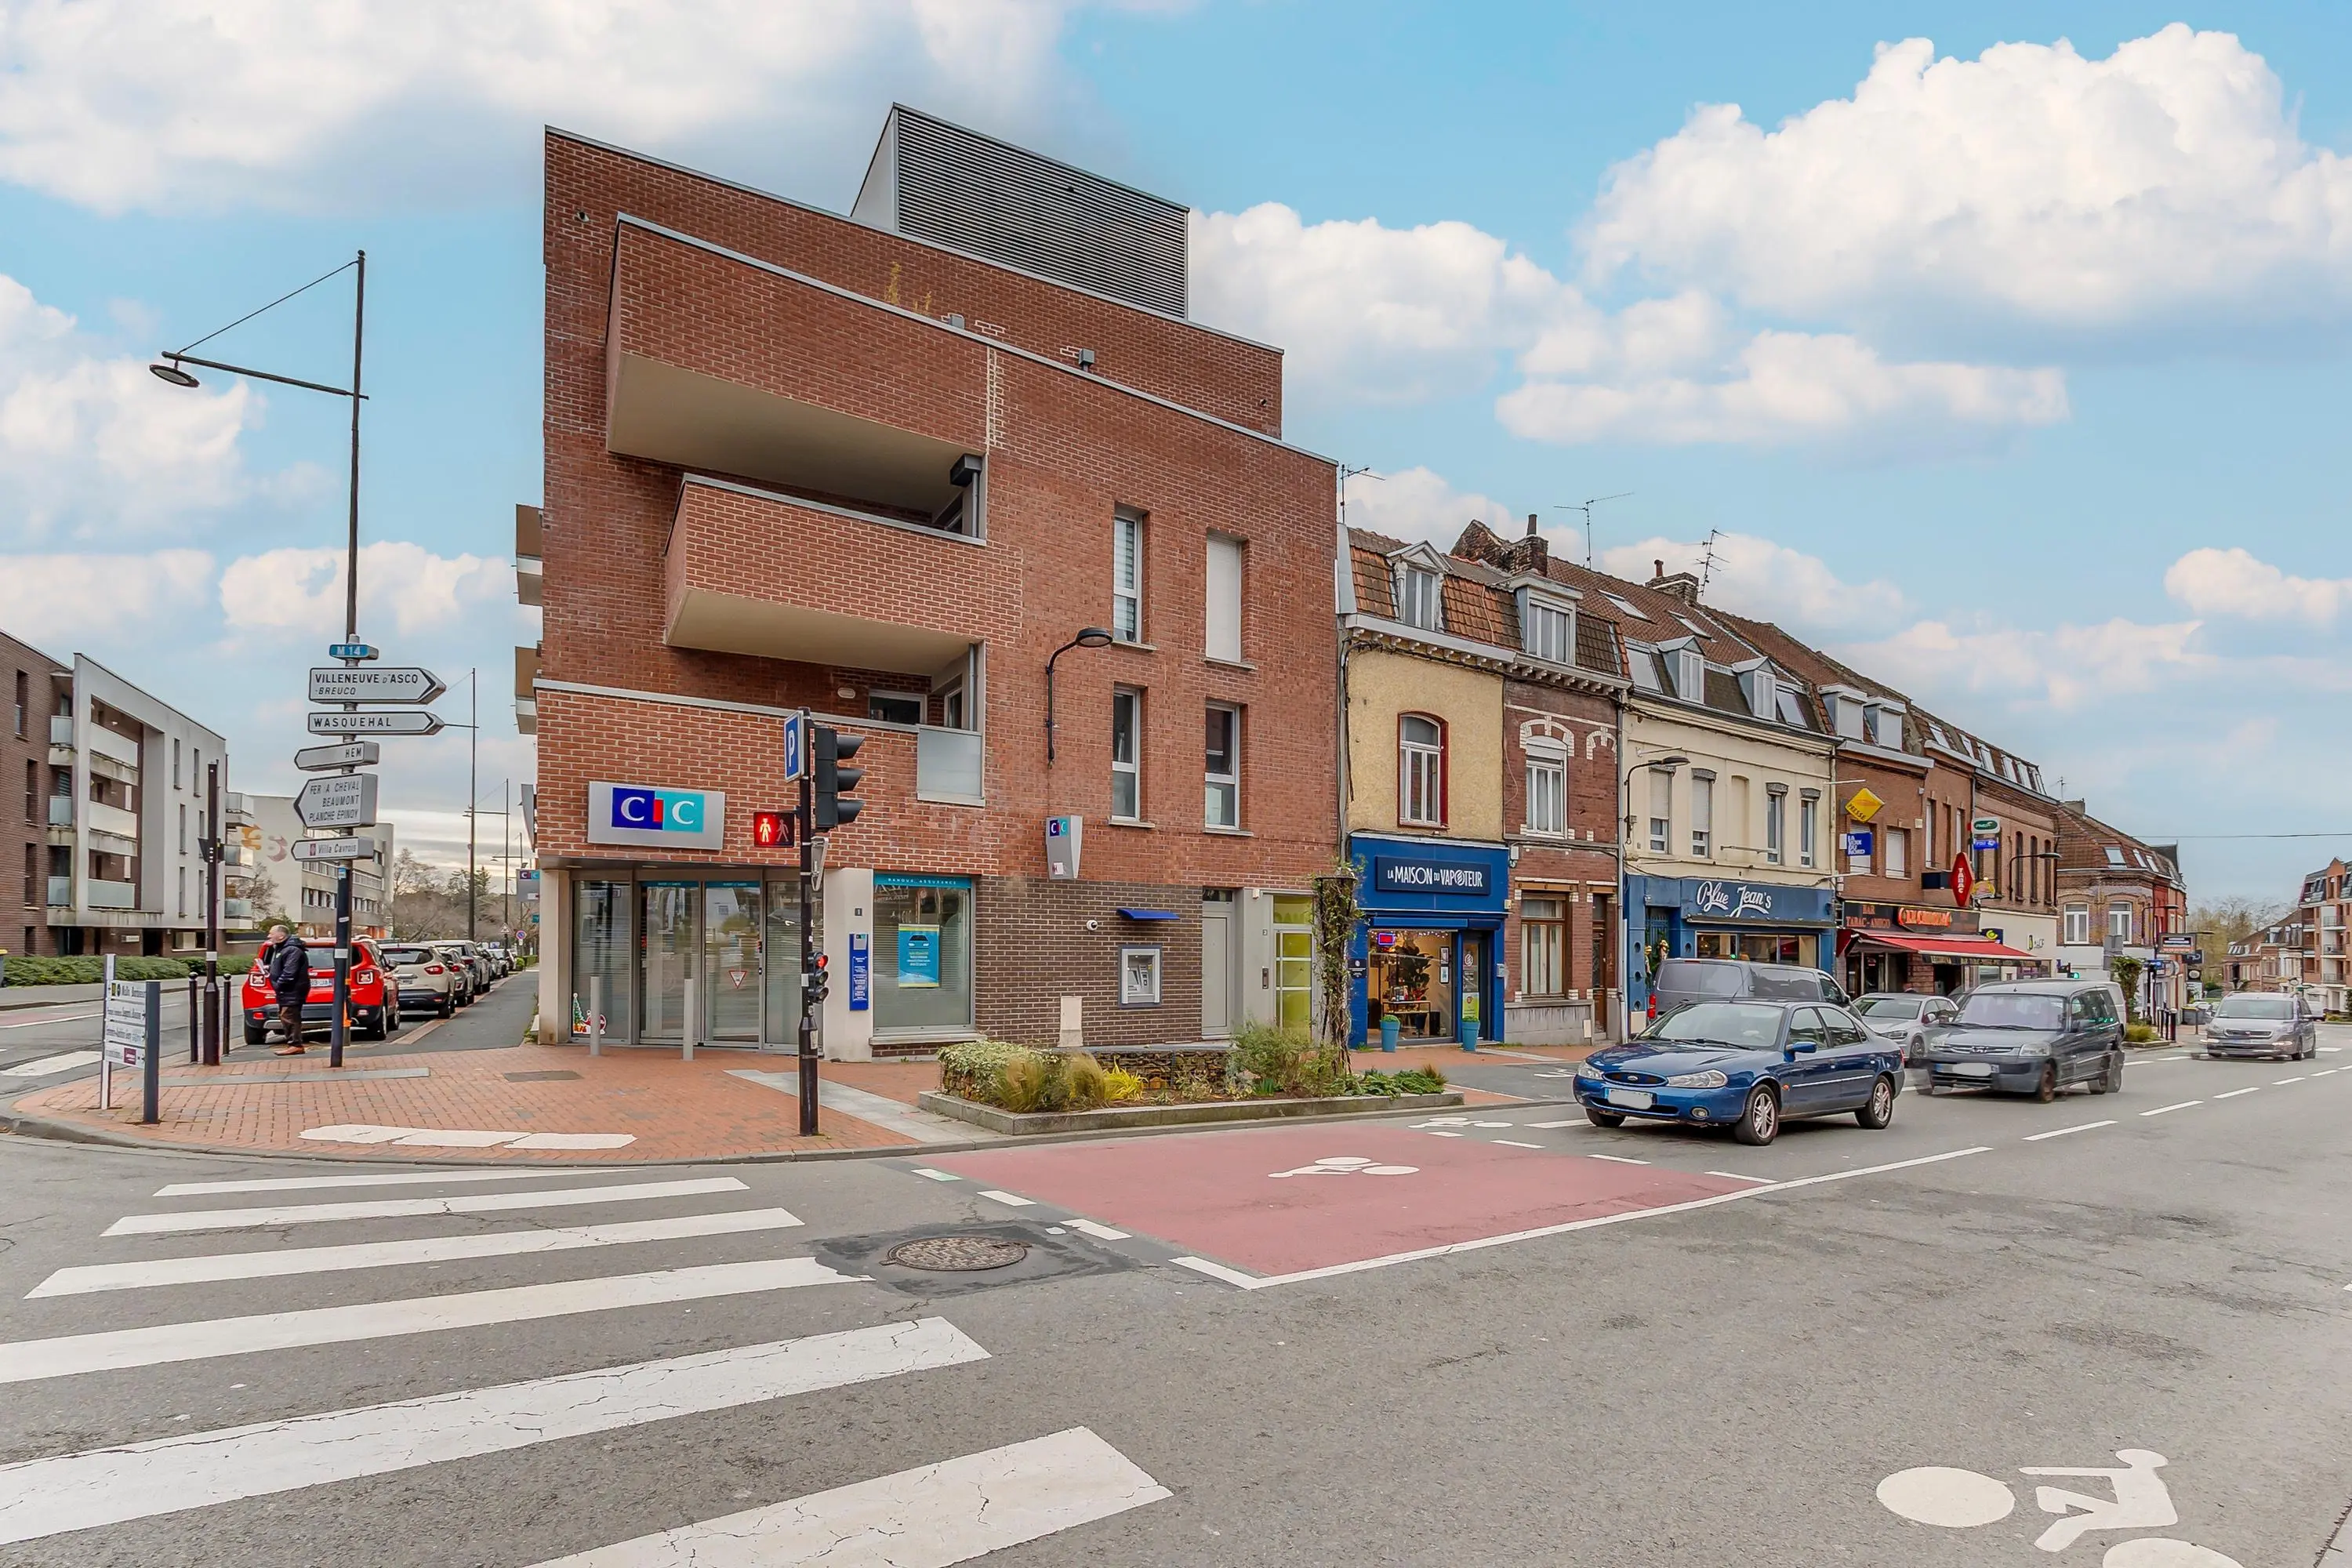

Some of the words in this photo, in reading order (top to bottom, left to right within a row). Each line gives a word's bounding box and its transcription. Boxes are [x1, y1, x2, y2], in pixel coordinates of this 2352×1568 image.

[337, 646, 345, 655] M
[349, 646, 361, 655] 14
[315, 674, 379, 683] VILLENEUVE
[314, 717, 391, 727] WASQUEHAL
[345, 748, 362, 758] HEM
[787, 729, 795, 768] P
[310, 785, 322, 795] FER
[335, 781, 359, 793] CHEVAL
[322, 795, 359, 808] BEAUMONT
[309, 811, 335, 822] PLANCHE
[336, 809, 358, 820] EPINOY
[620, 796, 695, 826] CIC
[1848, 804, 1866, 820] PRESSE
[1051, 822, 1067, 833] CIC
[318, 844, 332, 853] Villa
[1387, 869, 1394, 879] LA
[1395, 866, 1432, 884] MAISON
[1433, 873, 1440, 881] DU
[1440, 869, 1483, 887] VAPOTEUR
[1697, 881, 1729, 912] Blue
[1730, 885, 1772, 917] Jean's
[1862, 905, 1875, 915] BAR
[1846, 916, 1866, 927] TABAC
